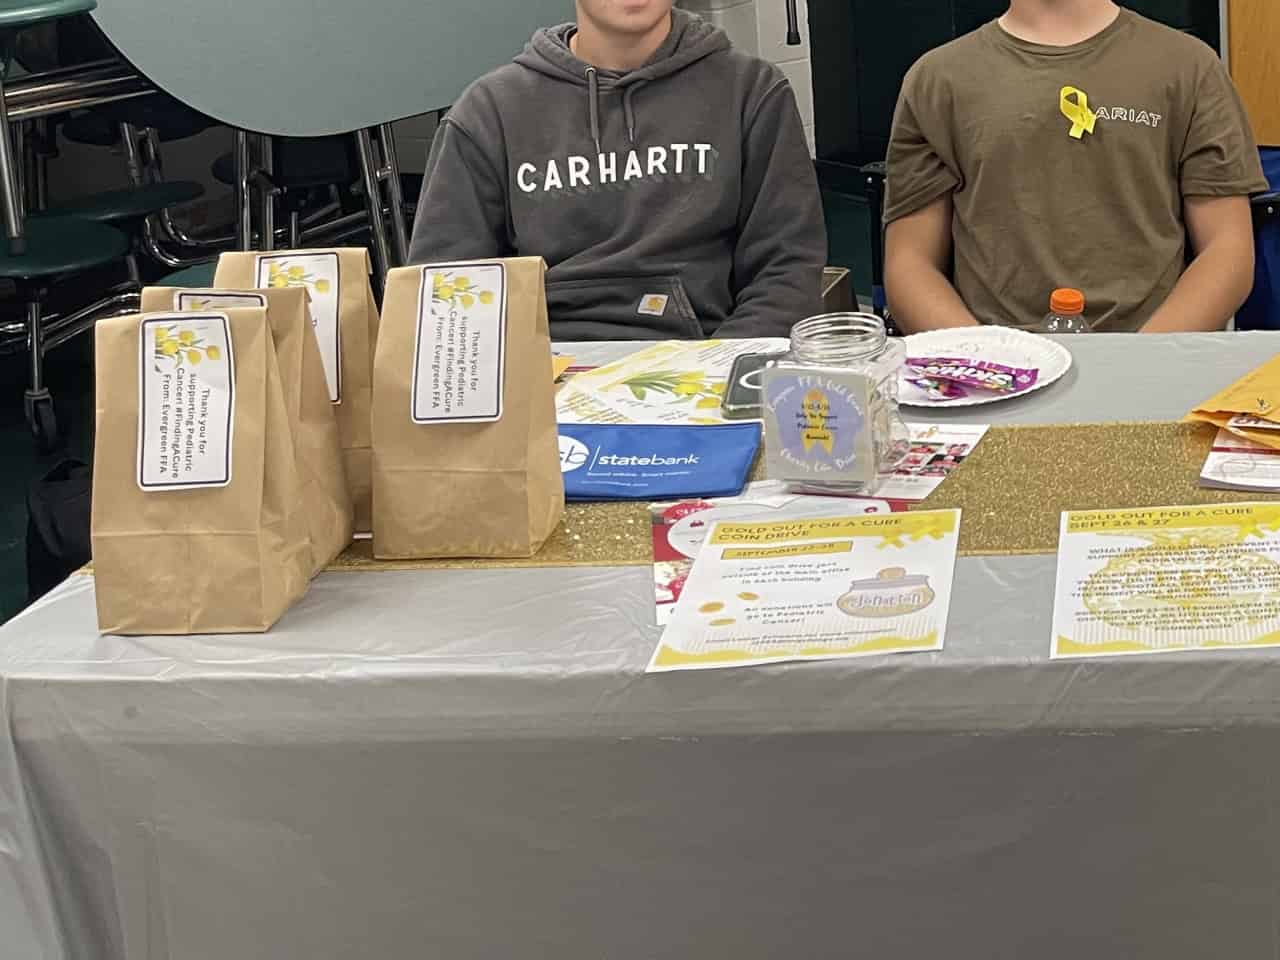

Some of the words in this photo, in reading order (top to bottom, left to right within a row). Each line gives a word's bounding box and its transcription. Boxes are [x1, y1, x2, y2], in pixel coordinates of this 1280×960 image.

[1096, 106, 1162, 127] ARIAT
[516, 143, 712, 192] CARHARTT
[457, 316, 468, 364] supporting
[471, 331, 480, 356] Thank
[432, 345, 442, 389] Evergreen
[457, 367, 466, 407] Pediatric
[471, 378, 479, 391] for
[186, 374, 196, 426] supporting
[200, 389, 210, 418] Thank
[432, 391, 440, 408] FFA
[160, 405, 169, 452] Evergreen
[199, 420, 207, 438] you
[185, 428, 194, 472] Pediatric
[199, 440, 207, 454] for
[598, 452, 700, 466] statebank
[1069, 520, 1106, 529] SEPT
[1151, 518, 1170, 526] 27
[1070, 514, 1118, 522] GOLD
[1121, 512, 1155, 520] OUT
[1159, 510, 1192, 519] FOR
[1211, 508, 1254, 516] CURE
[718, 532, 760, 541] COIN
[765, 529, 811, 539] DRIVE
[721, 525, 767, 534] GOLD
[771, 523, 806, 532] OUT
[809, 521, 841, 529] FOR
[861, 518, 903, 527] CURE
